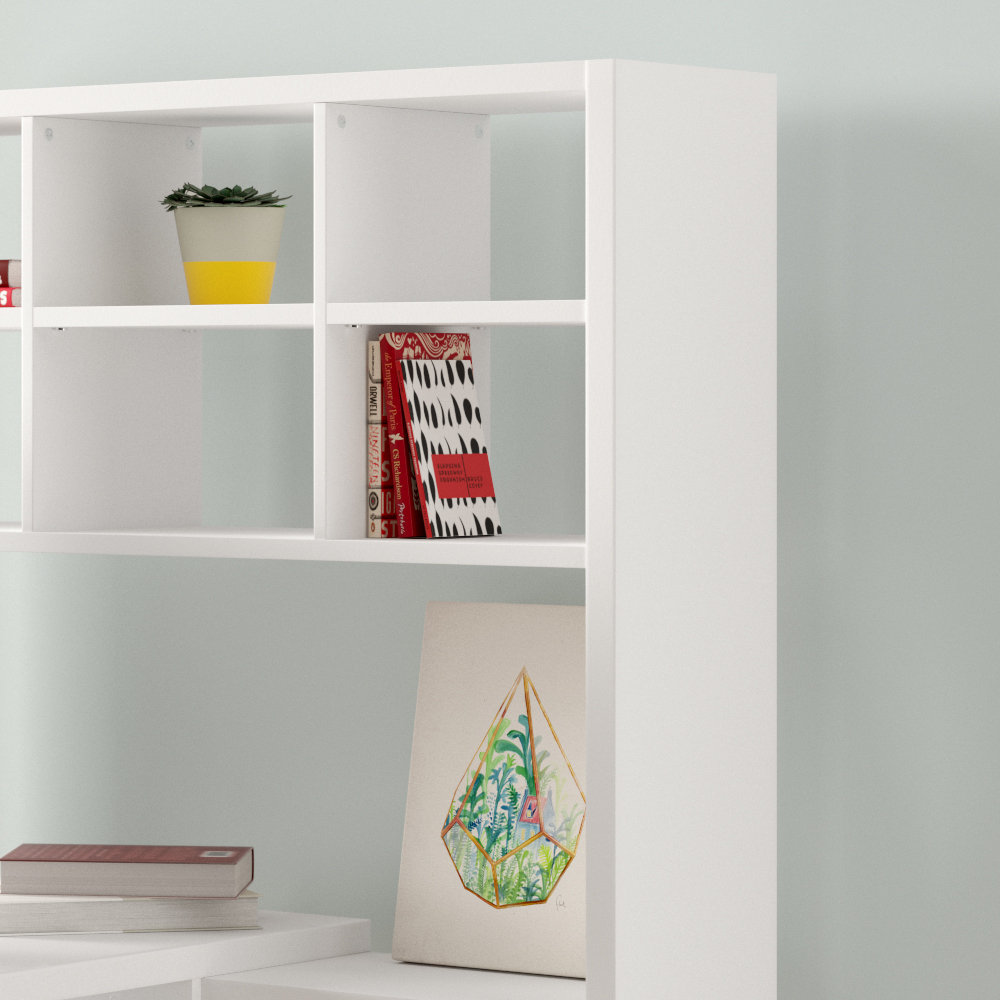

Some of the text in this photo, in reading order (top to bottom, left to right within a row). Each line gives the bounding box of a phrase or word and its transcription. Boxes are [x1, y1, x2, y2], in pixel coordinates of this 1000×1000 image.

[369, 386, 378, 416] ORWELL
[389, 408, 398, 431] Paris
[393, 460, 403, 500] Richardson
